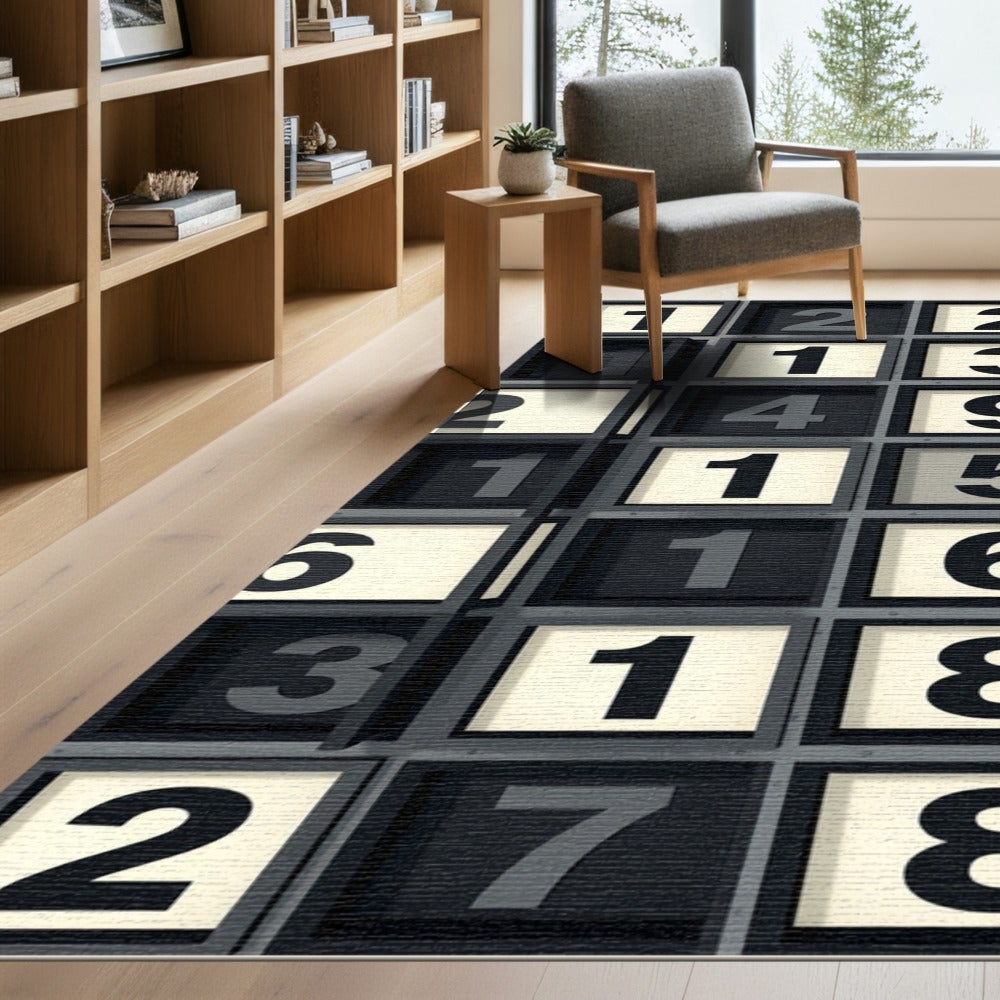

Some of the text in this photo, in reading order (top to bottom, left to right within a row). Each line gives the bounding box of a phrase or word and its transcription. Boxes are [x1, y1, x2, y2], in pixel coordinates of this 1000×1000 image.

[780, 308, 856, 331] 2
[772, 346, 829, 374] 1
[720, 394, 825, 429] 4
[471, 453, 548, 498] 1
[706, 453, 779, 498] 1
[242, 532, 375, 592] 6
[667, 529, 752, 588] 1
[225, 633, 408, 715] 3
[589, 636, 695, 720] 1
[0, 786, 253, 911] 2
[469, 785, 676, 910] 7
